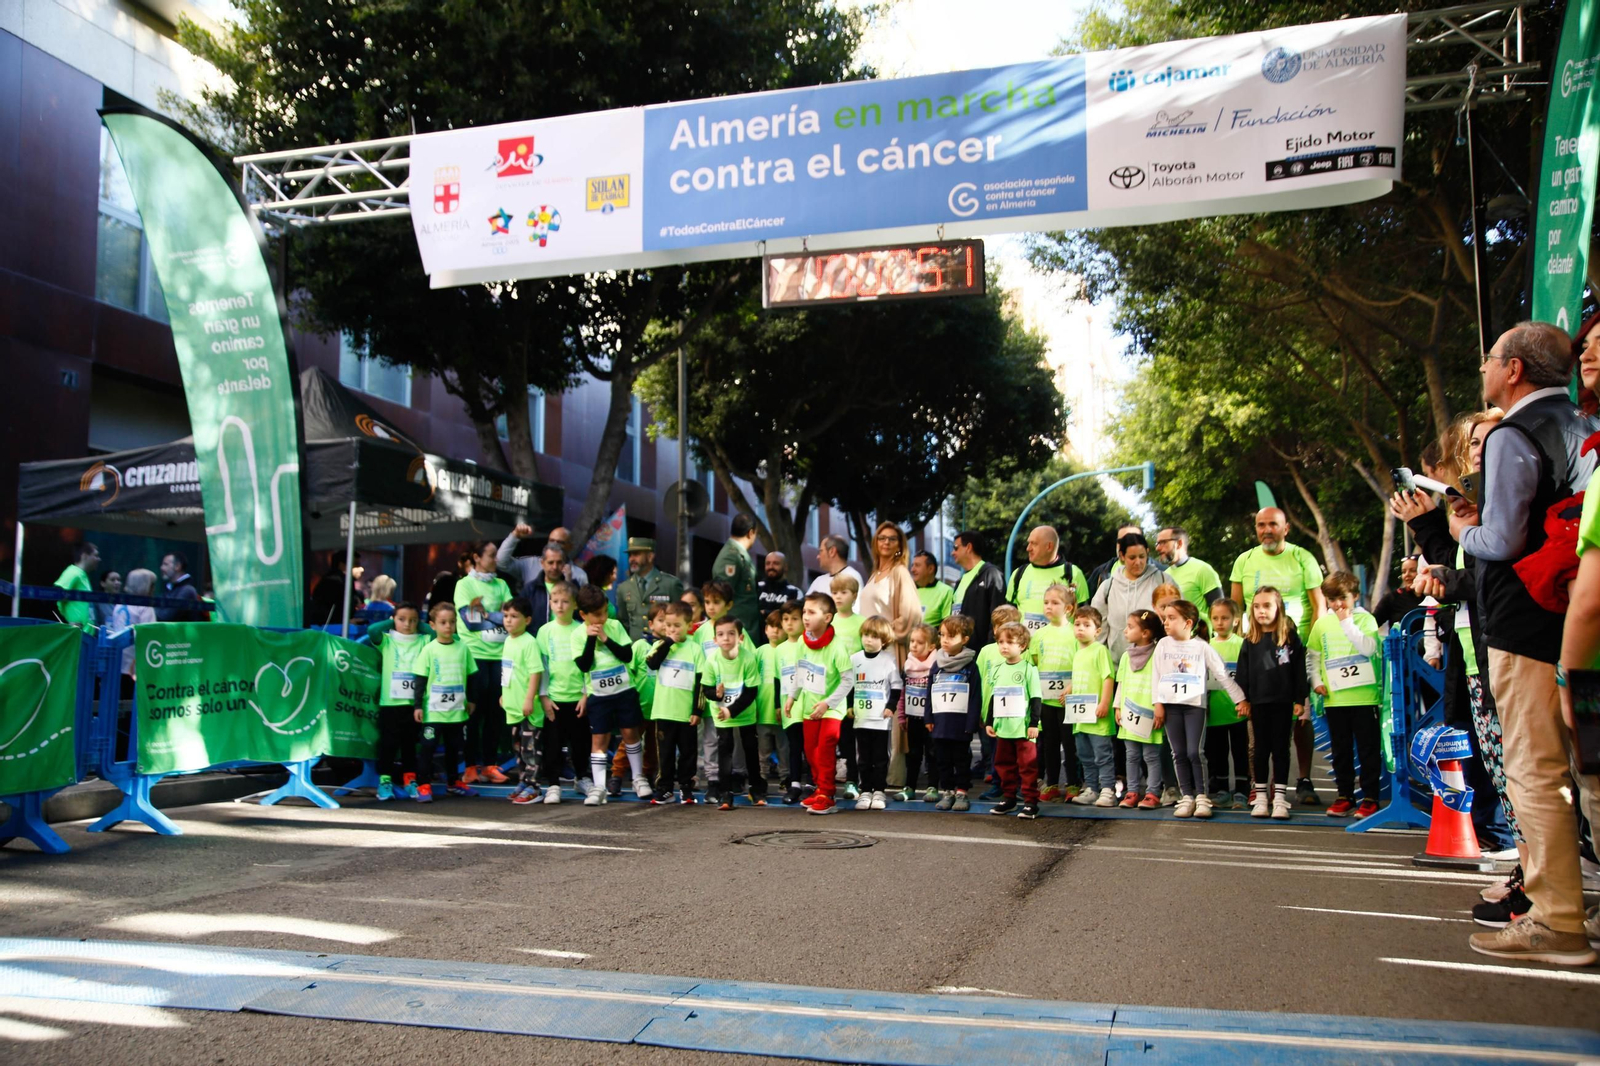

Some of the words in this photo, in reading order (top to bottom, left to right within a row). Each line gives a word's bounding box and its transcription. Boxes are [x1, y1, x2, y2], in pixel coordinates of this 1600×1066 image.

[1302, 43, 1385, 60] UNIVERSIDAD
[1303, 60, 1321, 71] DE
[1325, 53, 1385, 69] ALMERÍA
[1143, 64, 1231, 87] cajamar
[670, 104, 820, 151] Almería
[833, 102, 881, 129] en
[897, 81, 1057, 123] marcha
[1231, 103, 1337, 130] Fundación
[1146, 126, 1207, 138] MICHELIN
[1286, 134, 1322, 153] Ejido
[1327, 130, 1375, 144] Motor
[670, 156, 795, 194] contra
[807, 144, 845, 179] el
[857, 134, 1002, 174] cáncer
[1310, 160, 1332, 170] Jeep
[1337, 154, 1354, 170] FIAT
[1378, 152, 1393, 165] FIAT
[1152, 161, 1196, 174] Toyota
[984, 179, 1032, 191] asociación
[1034, 175, 1075, 187] española
[1152, 175, 1202, 187] Alborán
[1206, 171, 1245, 183] Motor
[1551, 169, 1562, 187] un
[985, 190, 1014, 201] contra
[1016, 189, 1024, 198] el
[1025, 187, 1056, 198] cáncer
[986, 203, 997, 211] en
[1000, 199, 1036, 210] Almería
[659, 217, 785, 237] #TodosContraElCáncer
[1548, 229, 1561, 251] por
[1547, 254, 1573, 275] delante
[125, 458, 200, 488] cruzand
[759, 592, 788, 603] PUMA
[1164, 653, 1193, 661] FROZEN
[673, 669, 680, 678] 7
[1340, 665, 1360, 678] 32
[198, 679, 210, 696] el
[599, 675, 623, 688] 886
[1048, 680, 1064, 690] 23
[1172, 683, 1187, 694] 11
[441, 693, 456, 703] 24
[941, 692, 957, 702] 17
[1000, 696, 1006, 707] 1
[196, 698, 223, 715] solo
[226, 698, 246, 711] un
[859, 700, 873, 709] 98
[1072, 704, 1086, 713] 15
[1127, 711, 1141, 725] 31
